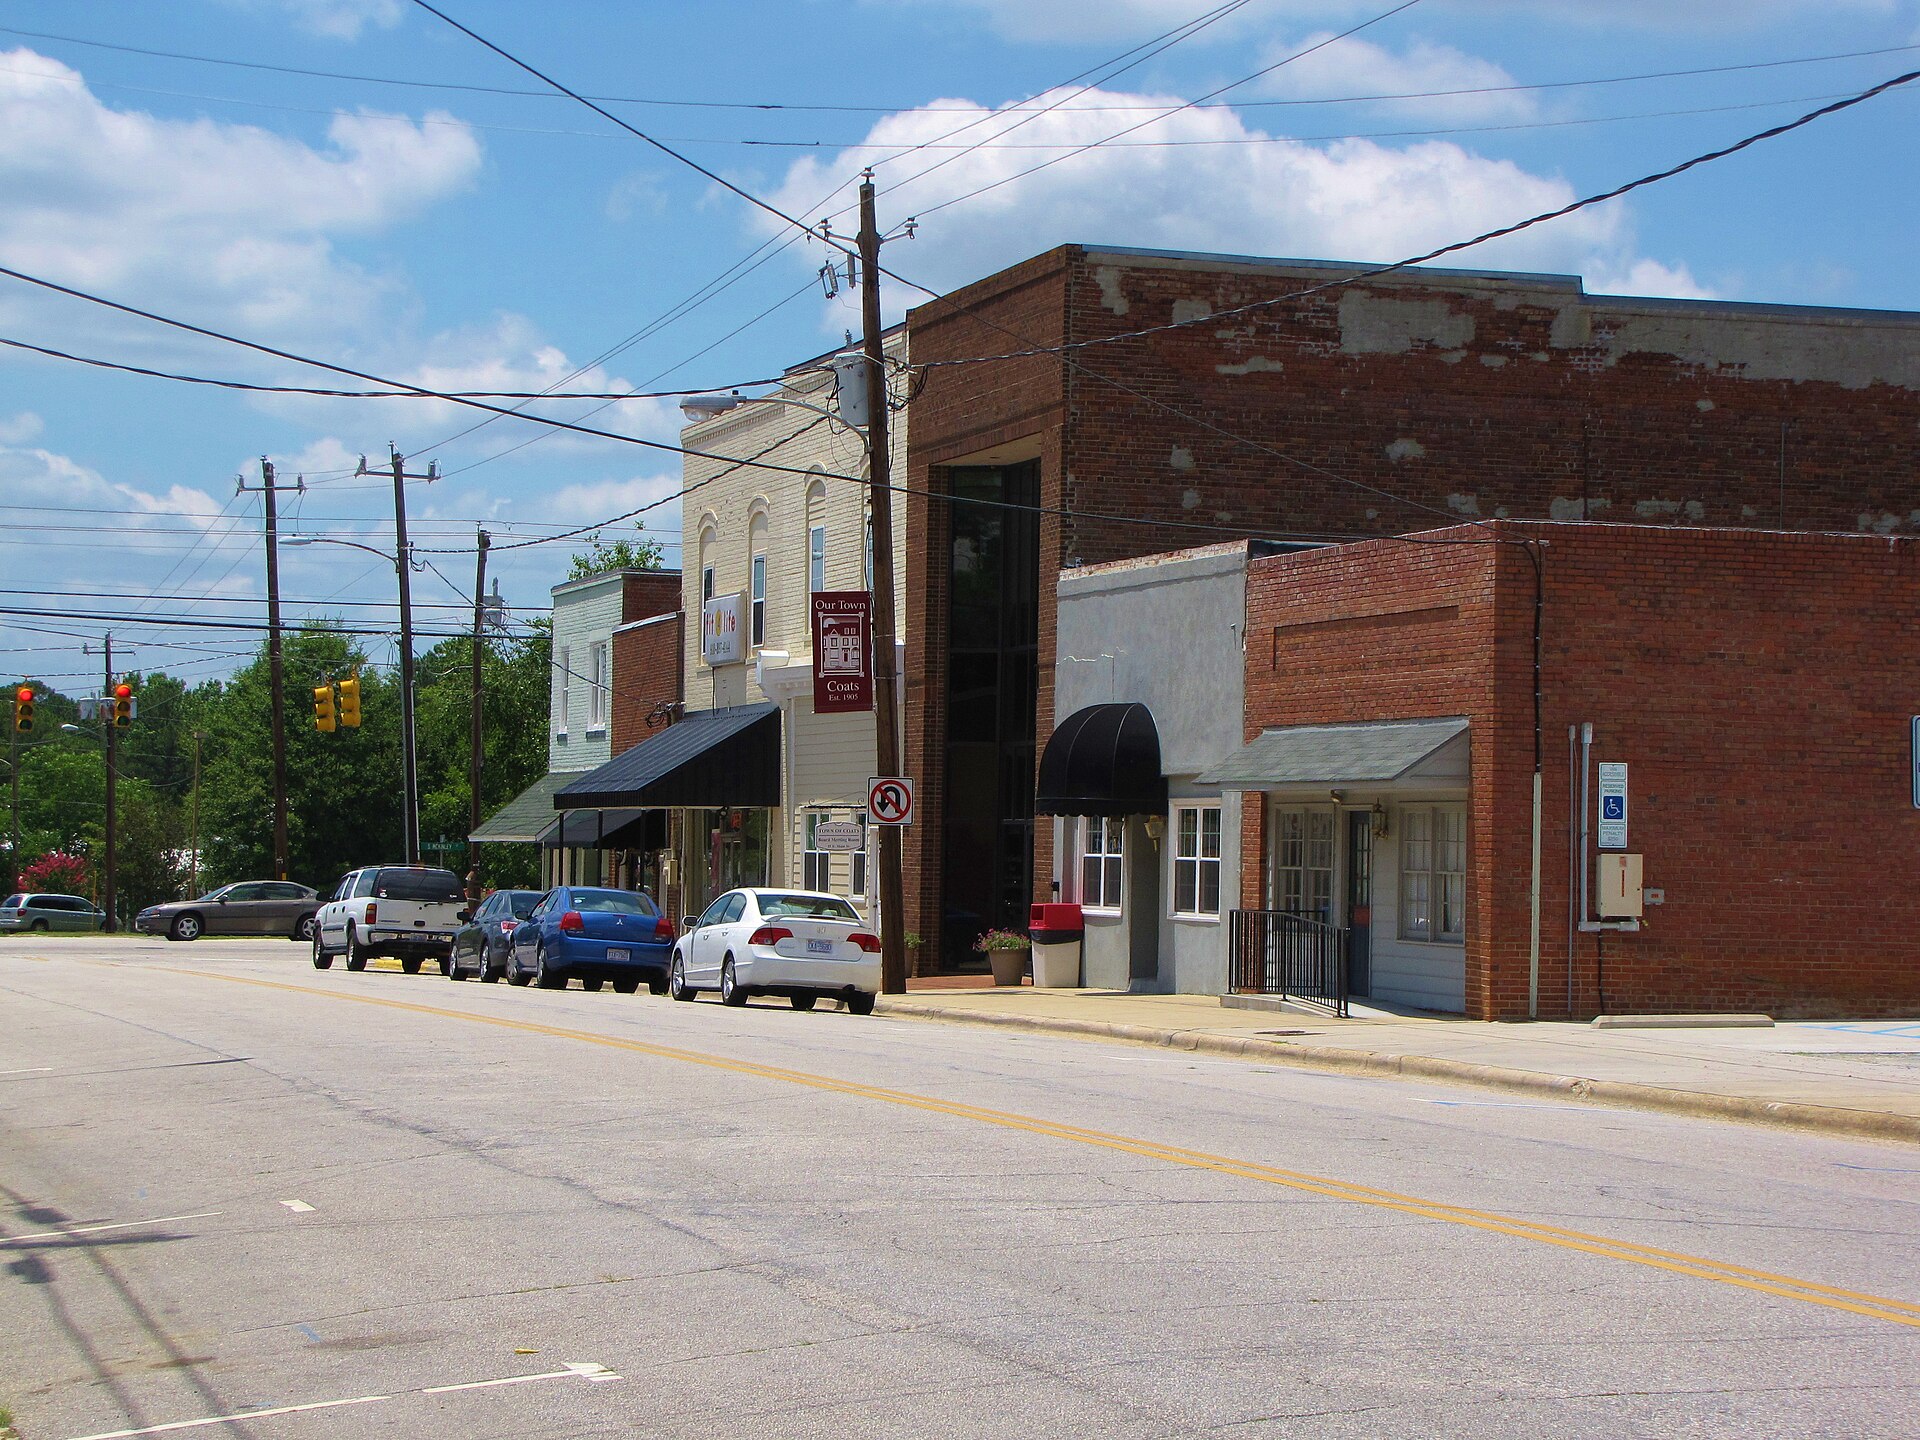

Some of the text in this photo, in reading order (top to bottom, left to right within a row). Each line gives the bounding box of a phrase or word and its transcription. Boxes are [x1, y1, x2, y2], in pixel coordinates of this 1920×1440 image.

[815, 599, 866, 610] Our Town
[723, 610, 736, 632] life
[827, 680, 860, 692] Coats
[843, 693, 859, 701] 1905
